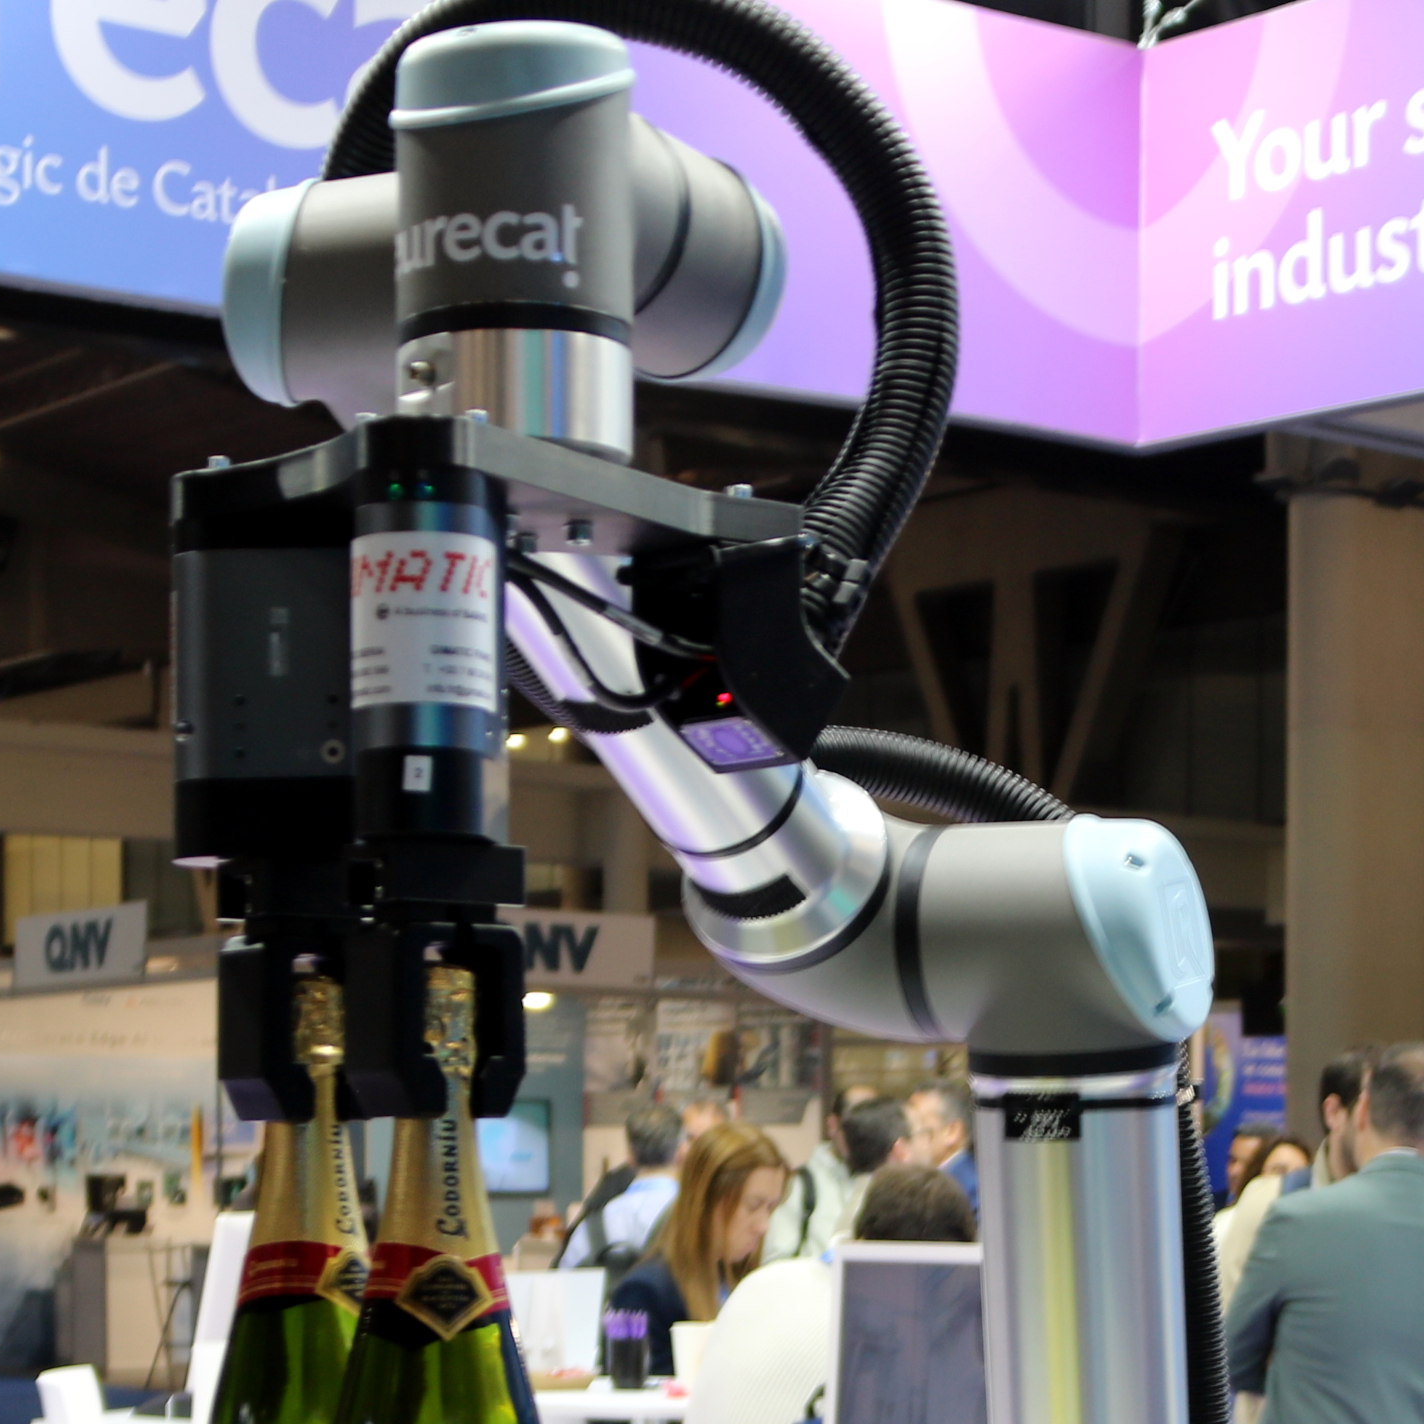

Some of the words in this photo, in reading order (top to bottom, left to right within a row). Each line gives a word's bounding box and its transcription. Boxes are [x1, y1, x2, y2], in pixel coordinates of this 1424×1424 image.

[76, 144, 141, 209] de
[1210, 108, 1387, 201] Your
[394, 203, 584, 276] urecat
[44, 916, 114, 973] QNV
[524, 921, 600, 974] NV
